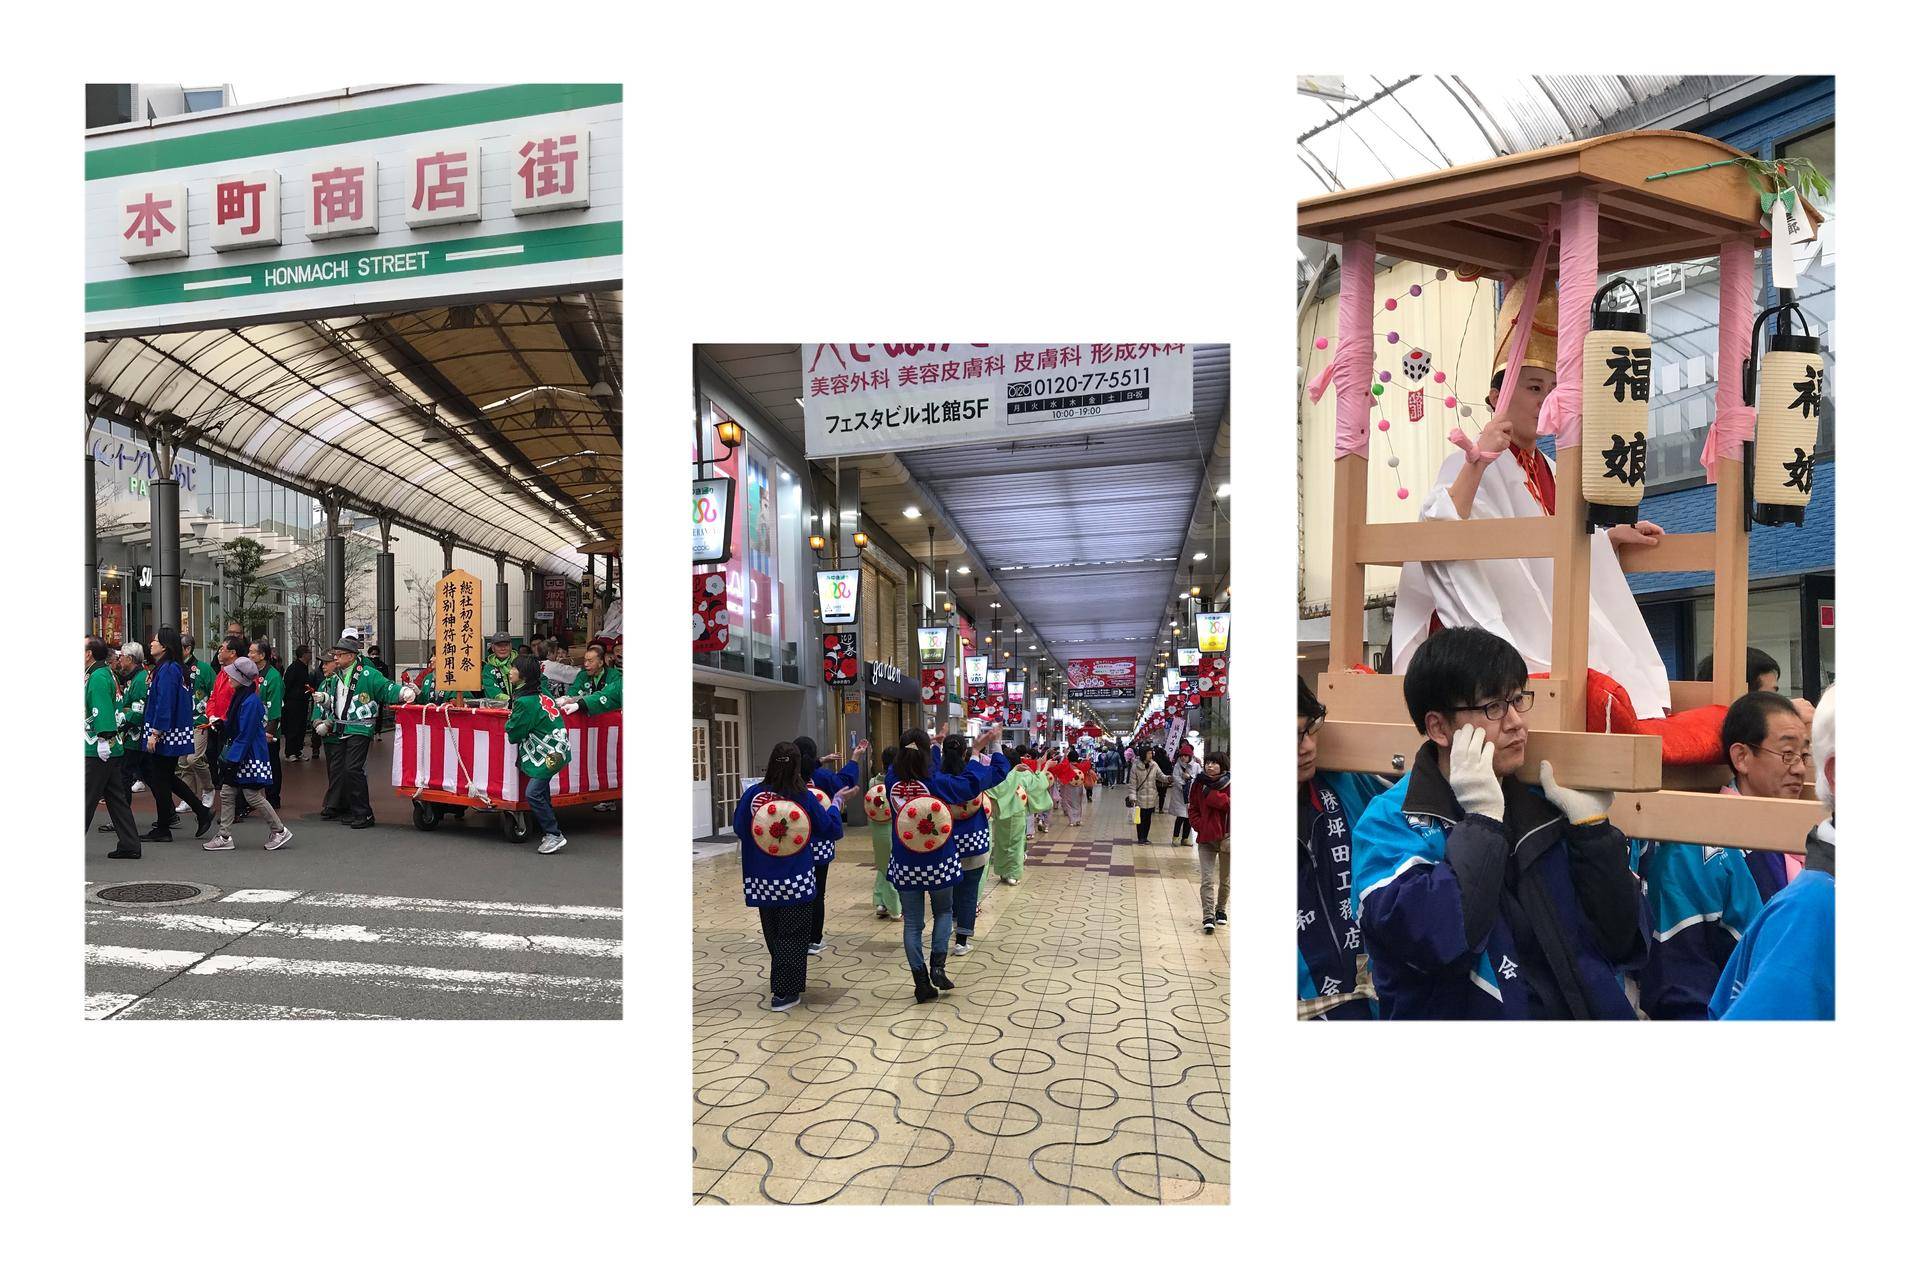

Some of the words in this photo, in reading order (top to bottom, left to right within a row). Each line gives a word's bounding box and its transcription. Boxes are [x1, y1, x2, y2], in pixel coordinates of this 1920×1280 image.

[123, 134, 579, 247] 本町商店街
[264, 259, 349, 287] HONMACHI
[357, 250, 430, 276] STREET
[810, 368, 891, 398] 美容外科
[898, 353, 1006, 387] 美容皮膚科
[1014, 344, 1082, 374] 皮膚科
[1034, 367, 1150, 396] 0120-77-5511
[825, 398, 990, 434] フェスタビル北館5F
[1601, 346, 1651, 487] 福娘
[441, 581, 457, 686] 特別神符御用車
[872, 656, 901, 685] garden
[1498, 955, 1519, 980] 会
